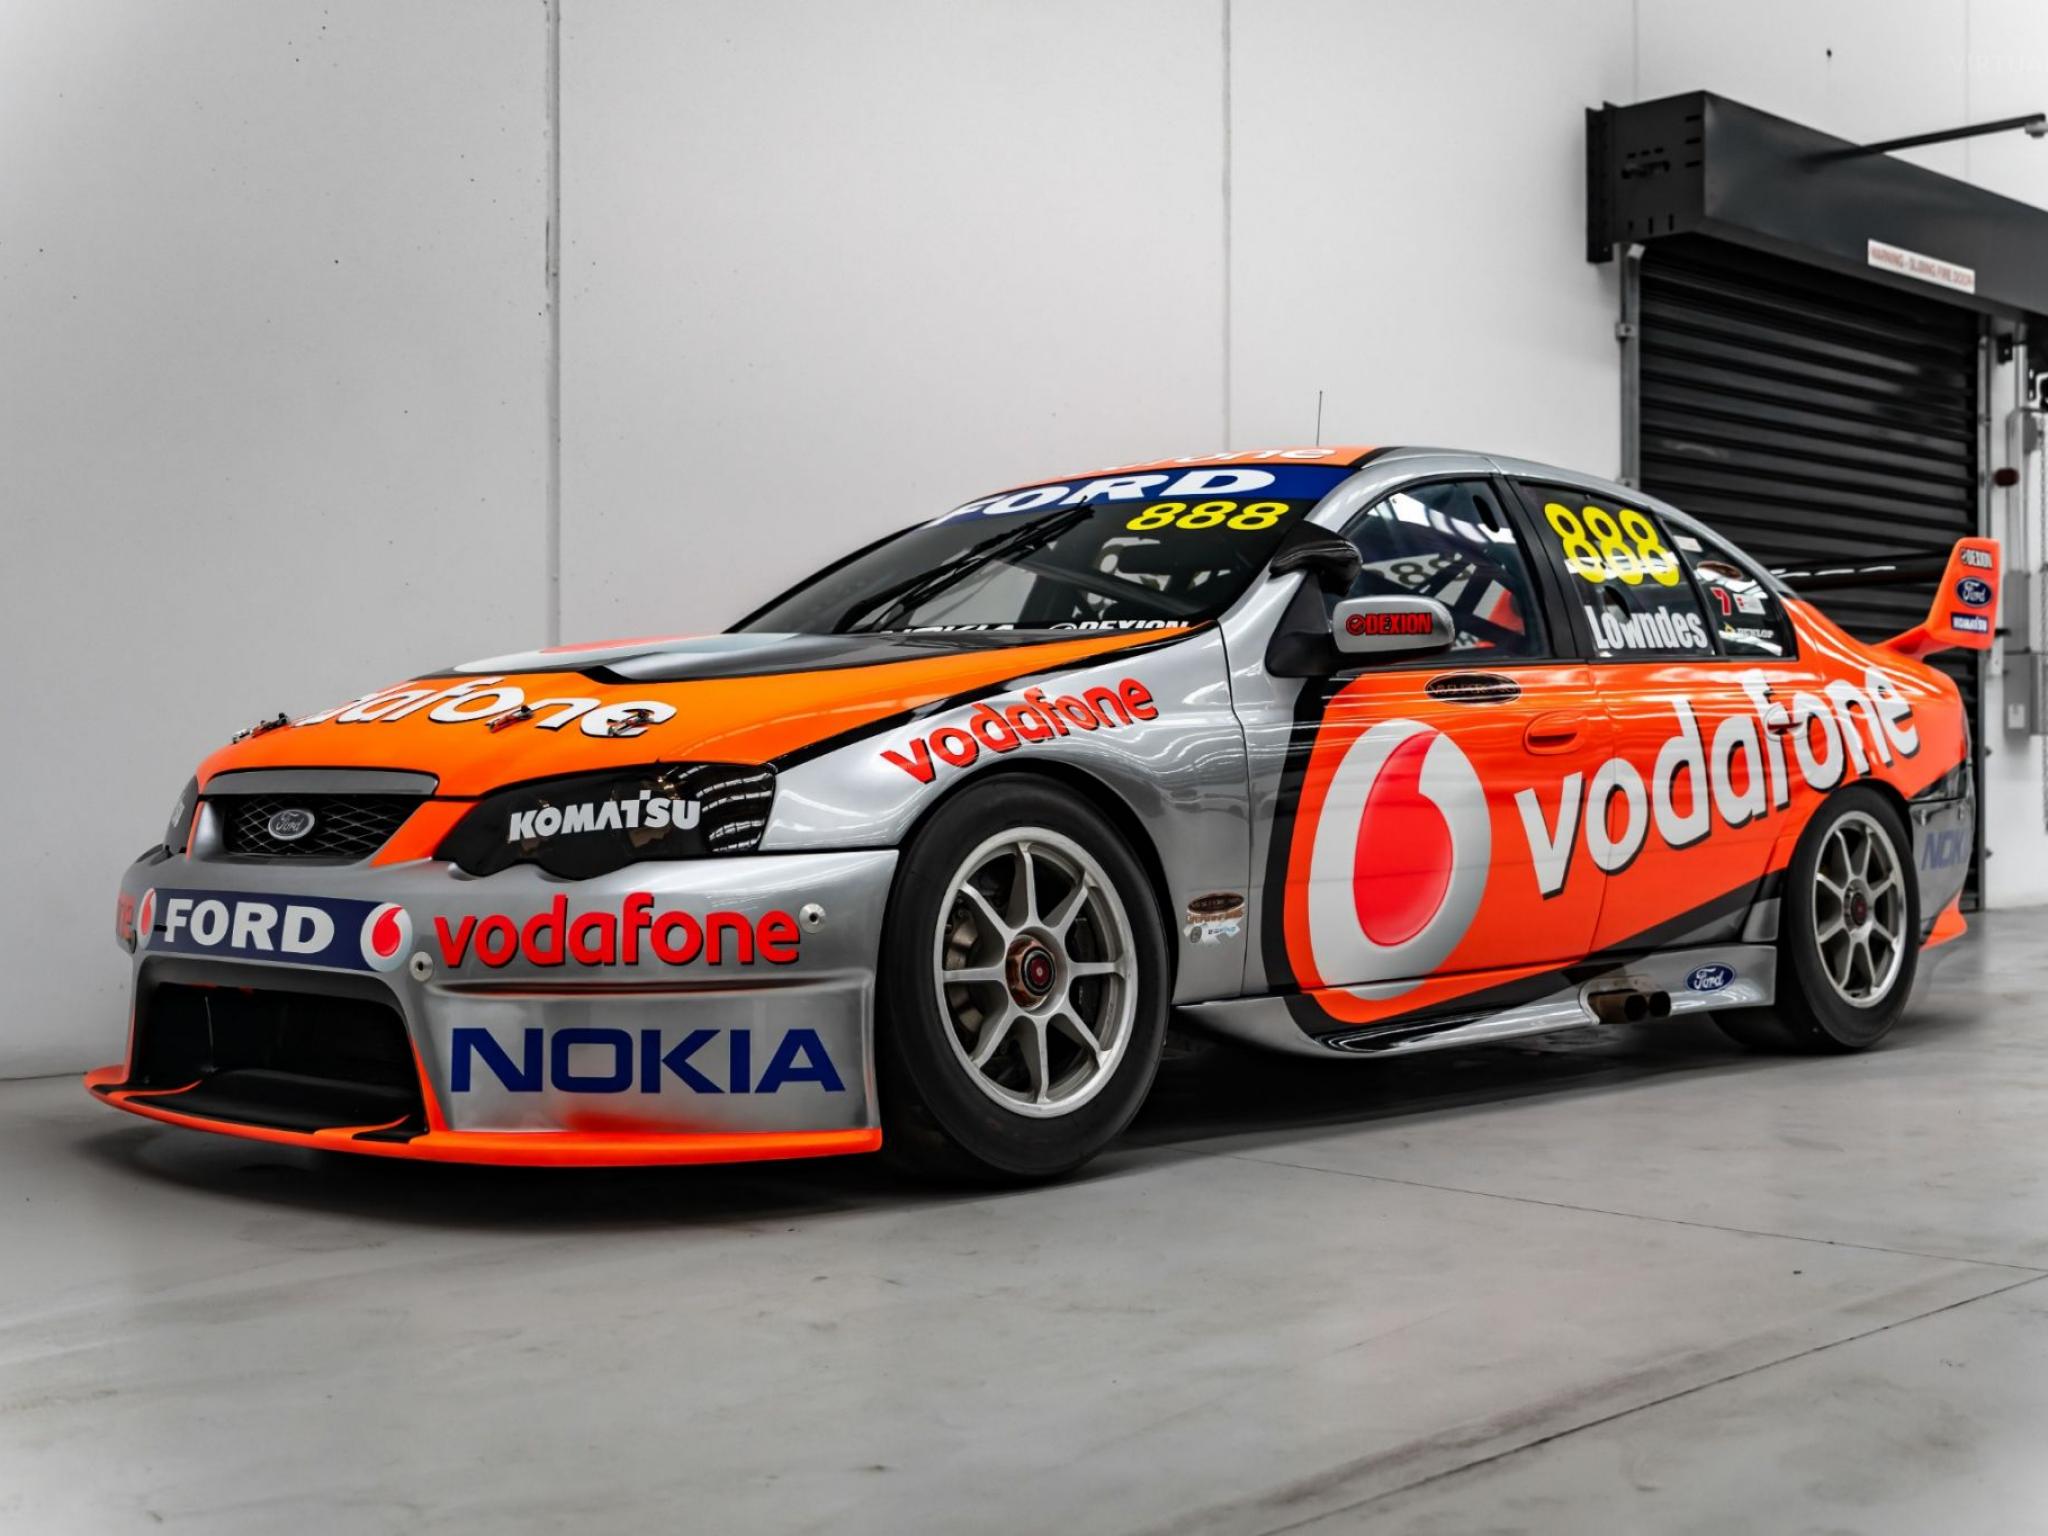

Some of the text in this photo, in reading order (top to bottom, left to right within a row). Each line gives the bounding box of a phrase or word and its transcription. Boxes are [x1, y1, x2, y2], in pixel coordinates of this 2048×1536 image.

[920, 469, 1276, 529] FORD
[1126, 501, 1290, 531] 888
[1544, 502, 1680, 587] 888
[1365, 612, 1432, 635] DEXION
[1584, 605, 1708, 649] Lowndes
[291, 676, 678, 738] dafone
[880, 678, 1159, 784] vodafone
[1514, 666, 1921, 900] vodafone
[507, 789, 701, 843] KOMATSU
[1920, 829, 1970, 872] NOK
[164, 898, 335, 954] FORD
[434, 892, 801, 968] vodafone
[451, 1027, 847, 1095] NOKIA
